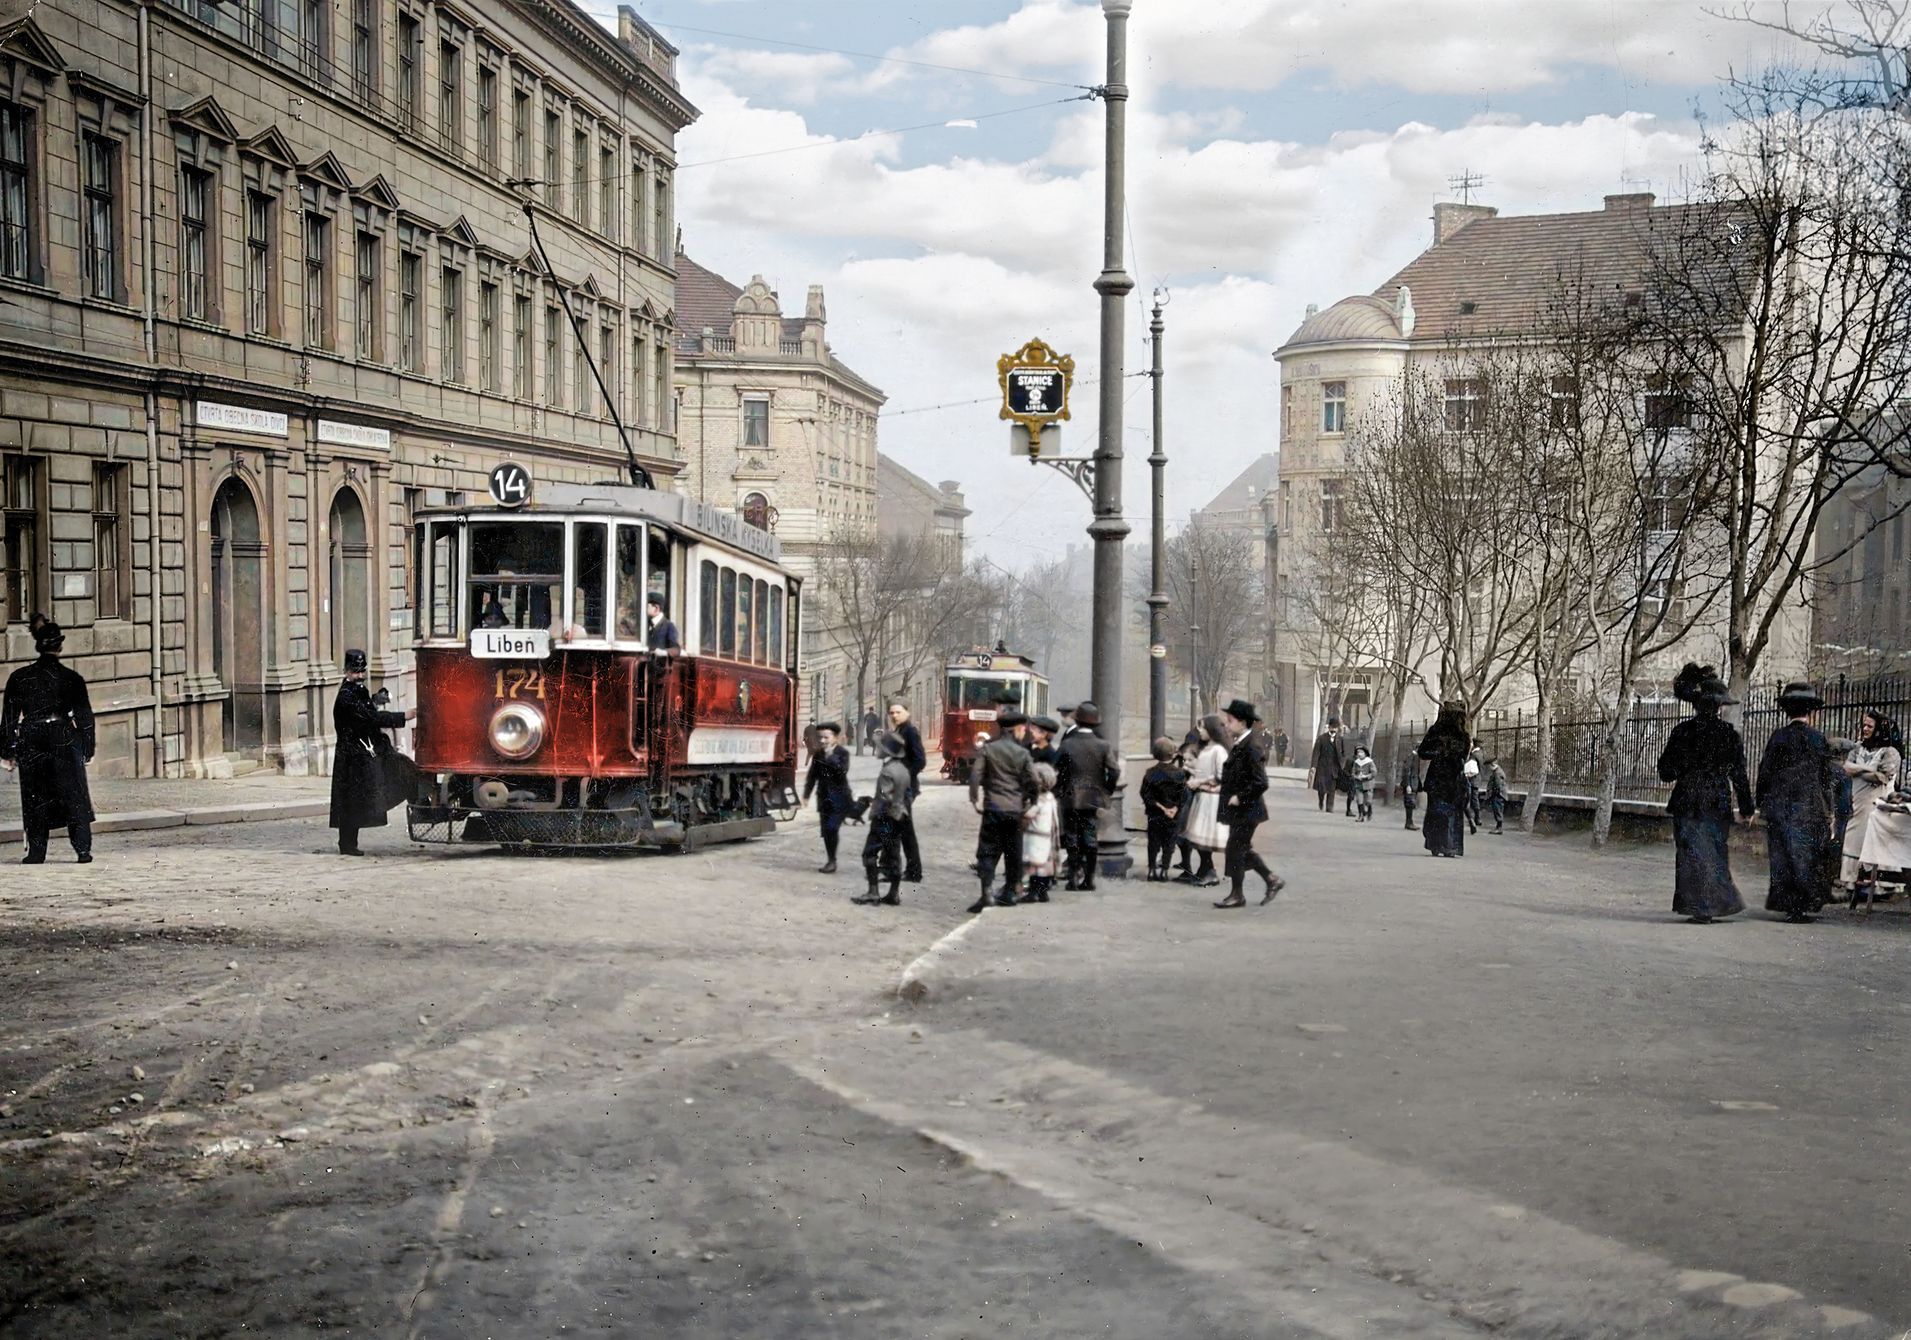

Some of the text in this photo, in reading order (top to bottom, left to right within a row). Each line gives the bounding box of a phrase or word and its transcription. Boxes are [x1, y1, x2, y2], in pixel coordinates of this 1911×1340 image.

[1018, 375, 1053, 386] STANICE
[494, 468, 526, 501] 14
[979, 656, 990, 667] 14
[495, 668, 544, 699] 174
